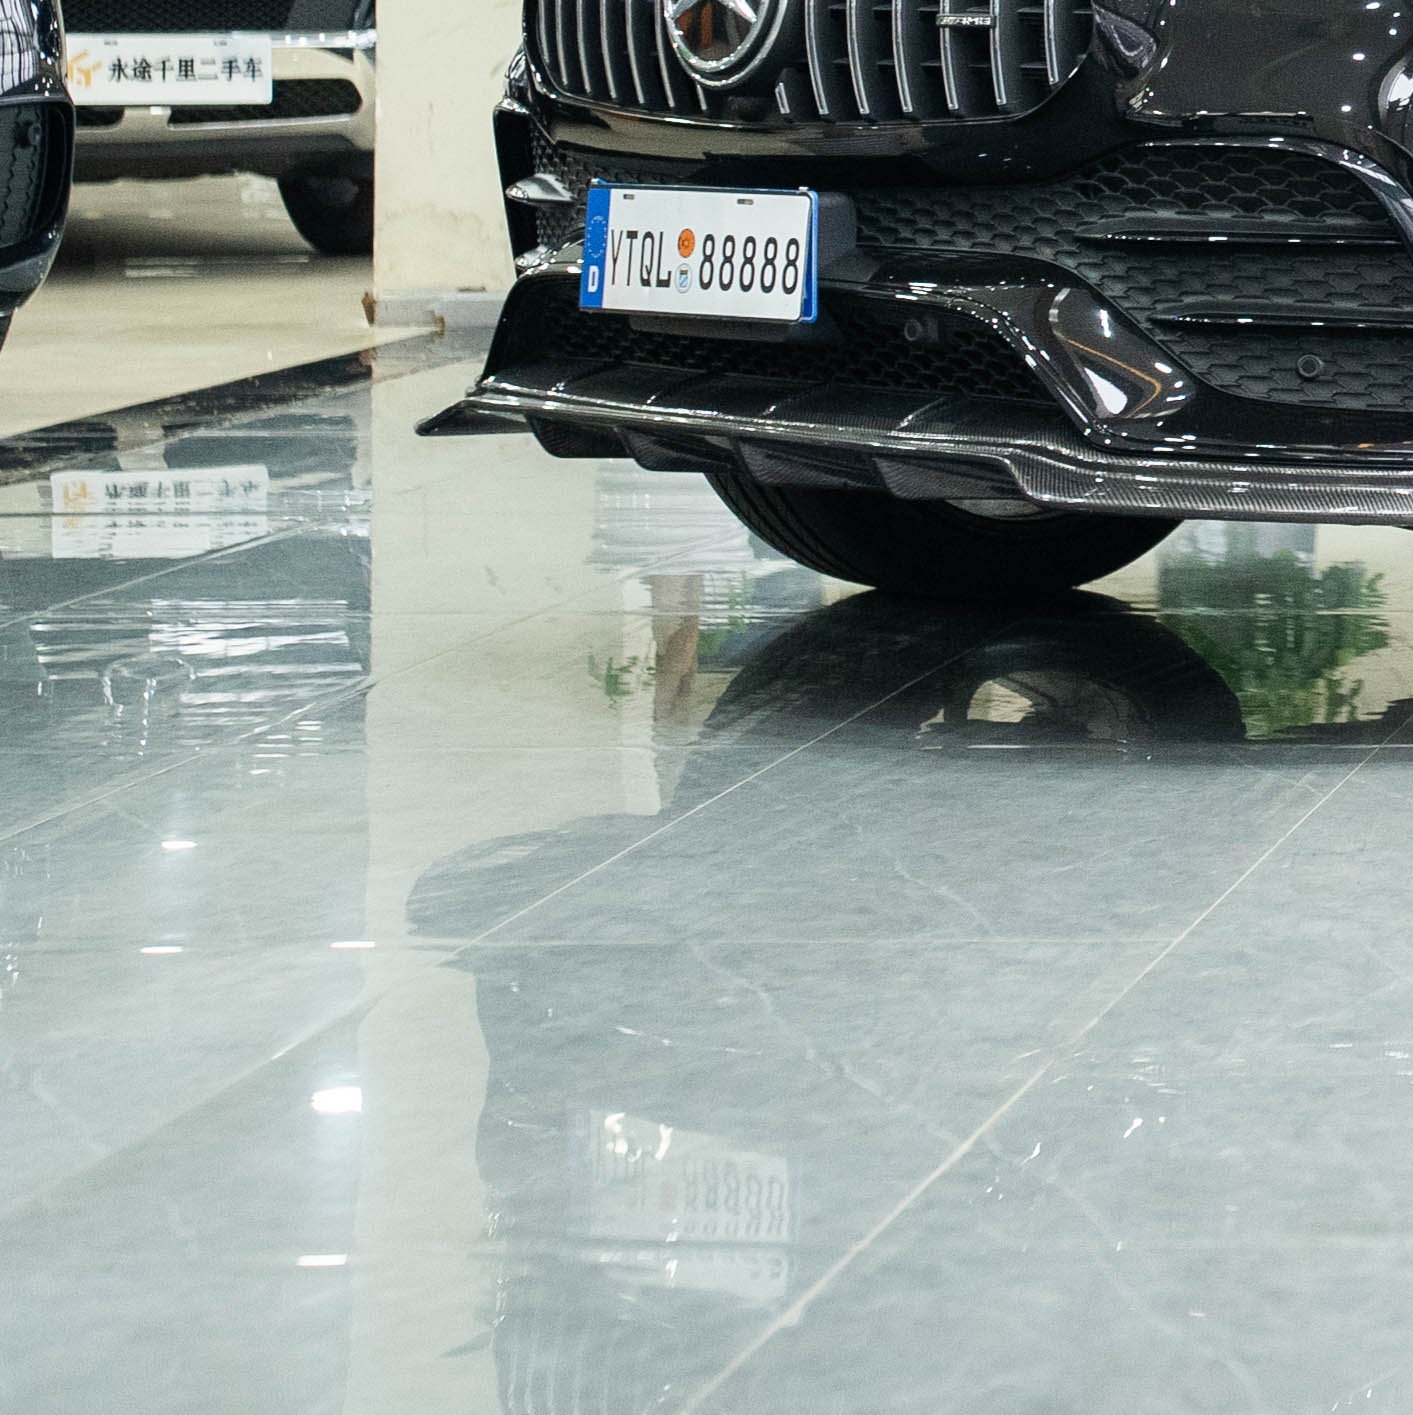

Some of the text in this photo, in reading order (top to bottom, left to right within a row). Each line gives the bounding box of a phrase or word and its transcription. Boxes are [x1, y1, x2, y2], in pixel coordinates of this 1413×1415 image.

[108, 55, 264, 82] 永途千里二手车
[610, 229, 800, 295] YTQL 88888
[587, 265, 599, 293] D
